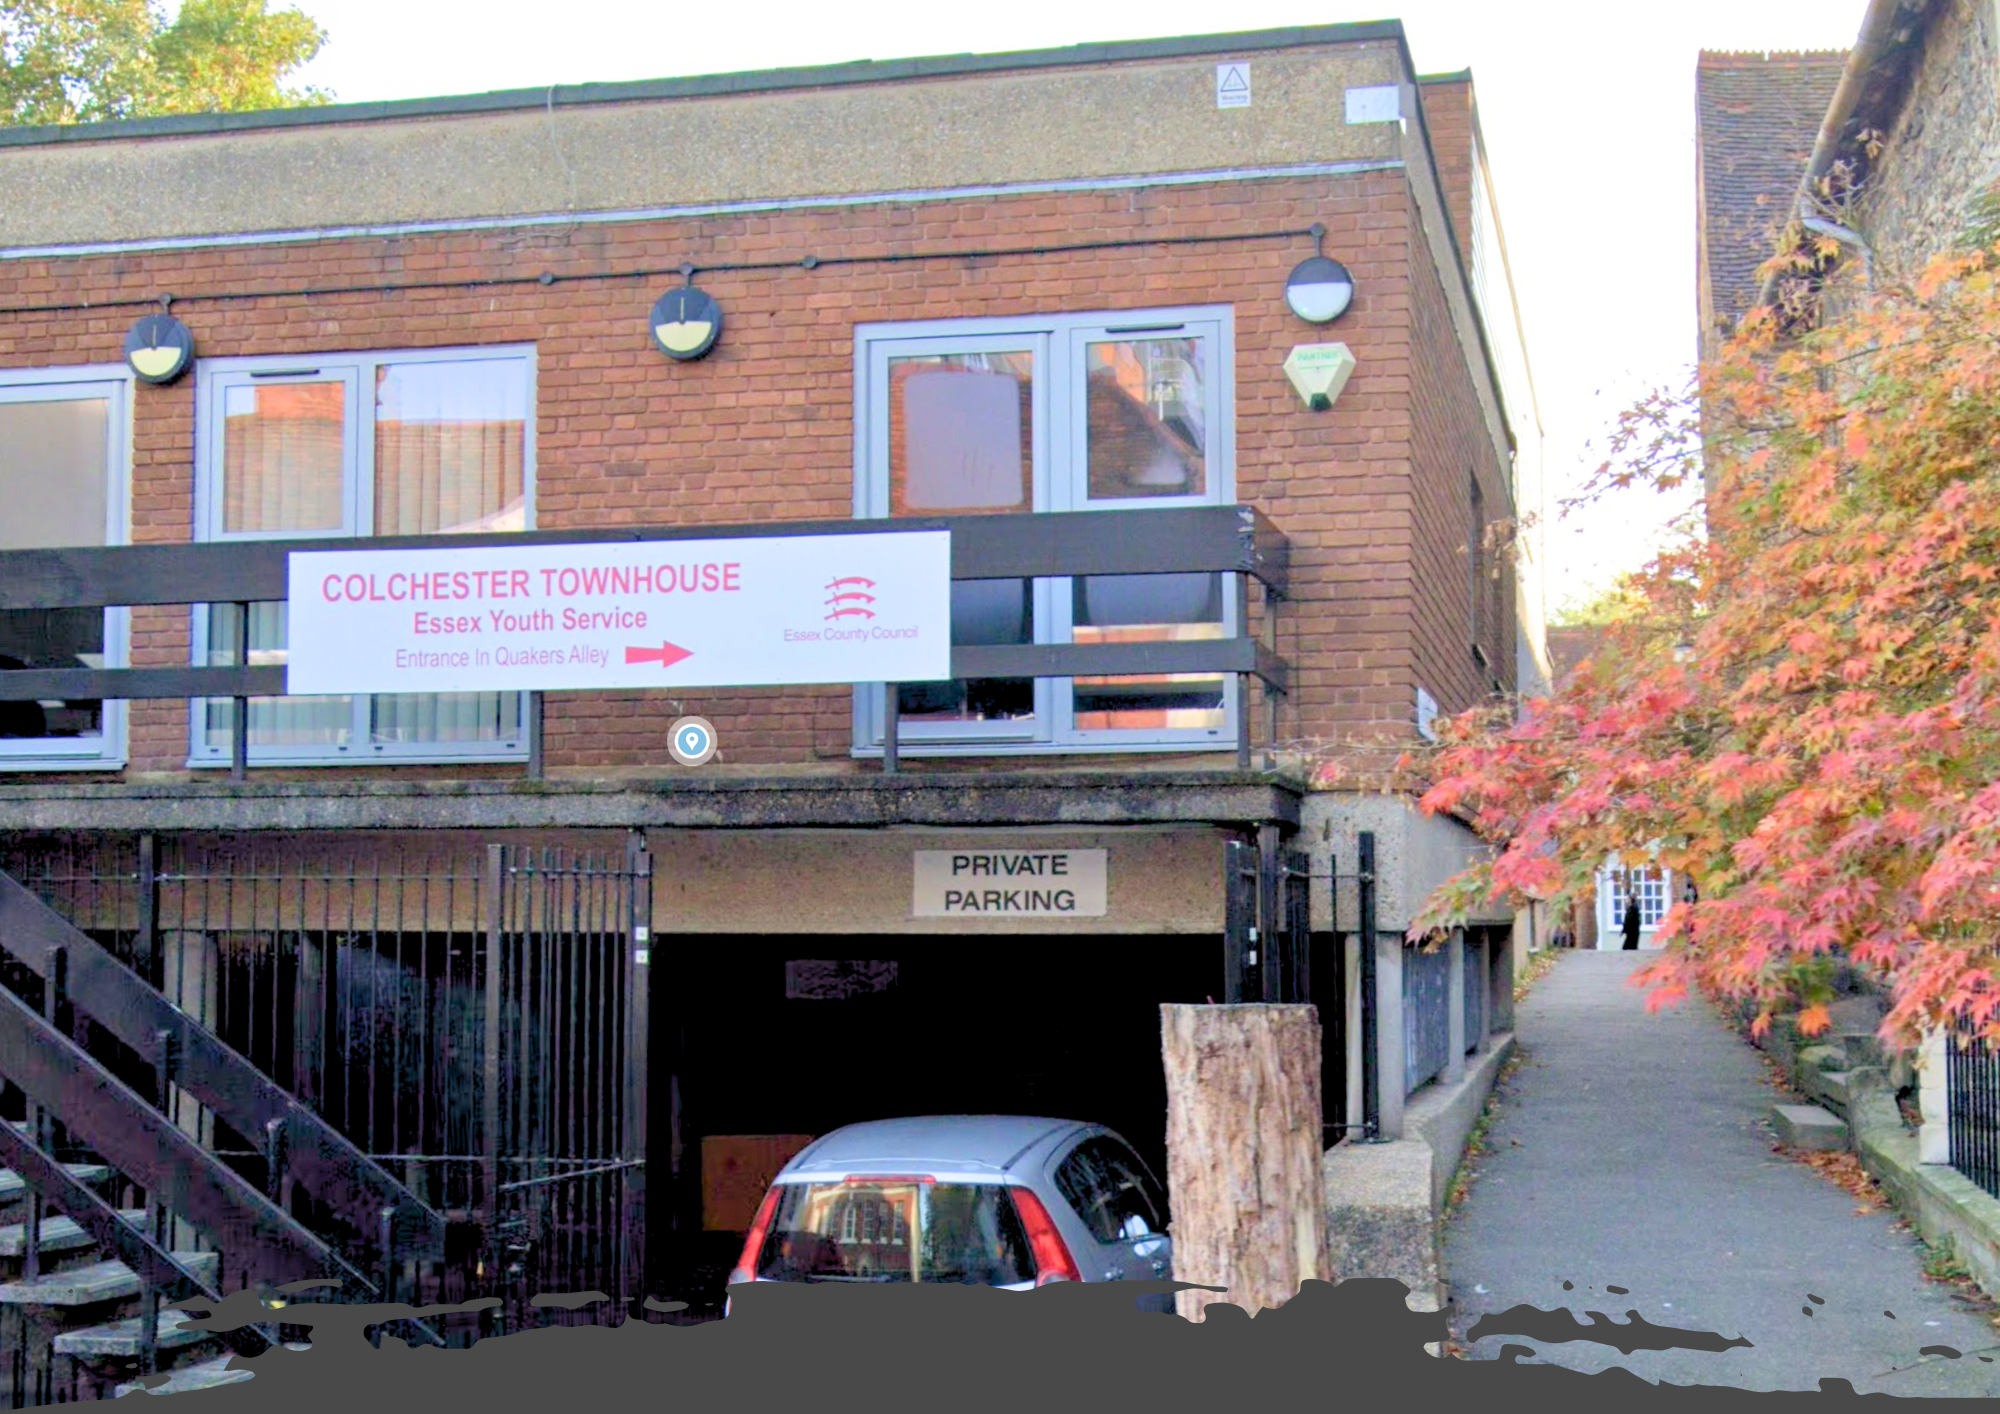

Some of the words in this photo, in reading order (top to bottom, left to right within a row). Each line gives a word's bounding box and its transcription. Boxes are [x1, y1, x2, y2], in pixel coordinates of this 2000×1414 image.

[322, 570, 530, 602] COLCHESTER
[540, 562, 741, 597] TOWNHOUSE
[413, 612, 482, 634] Essex
[489, 609, 554, 632] Youth
[562, 606, 648, 630] Service
[783, 629, 821, 642] Essex
[824, 627, 870, 643] County
[871, 626, 919, 639] Council
[395, 648, 469, 668] Entrance
[475, 647, 490, 666] In
[495, 646, 565, 667] Quakers
[568, 645, 609, 669] Alley
[952, 854, 1068, 876] PRIVATE
[944, 889, 1076, 911] PARKING
